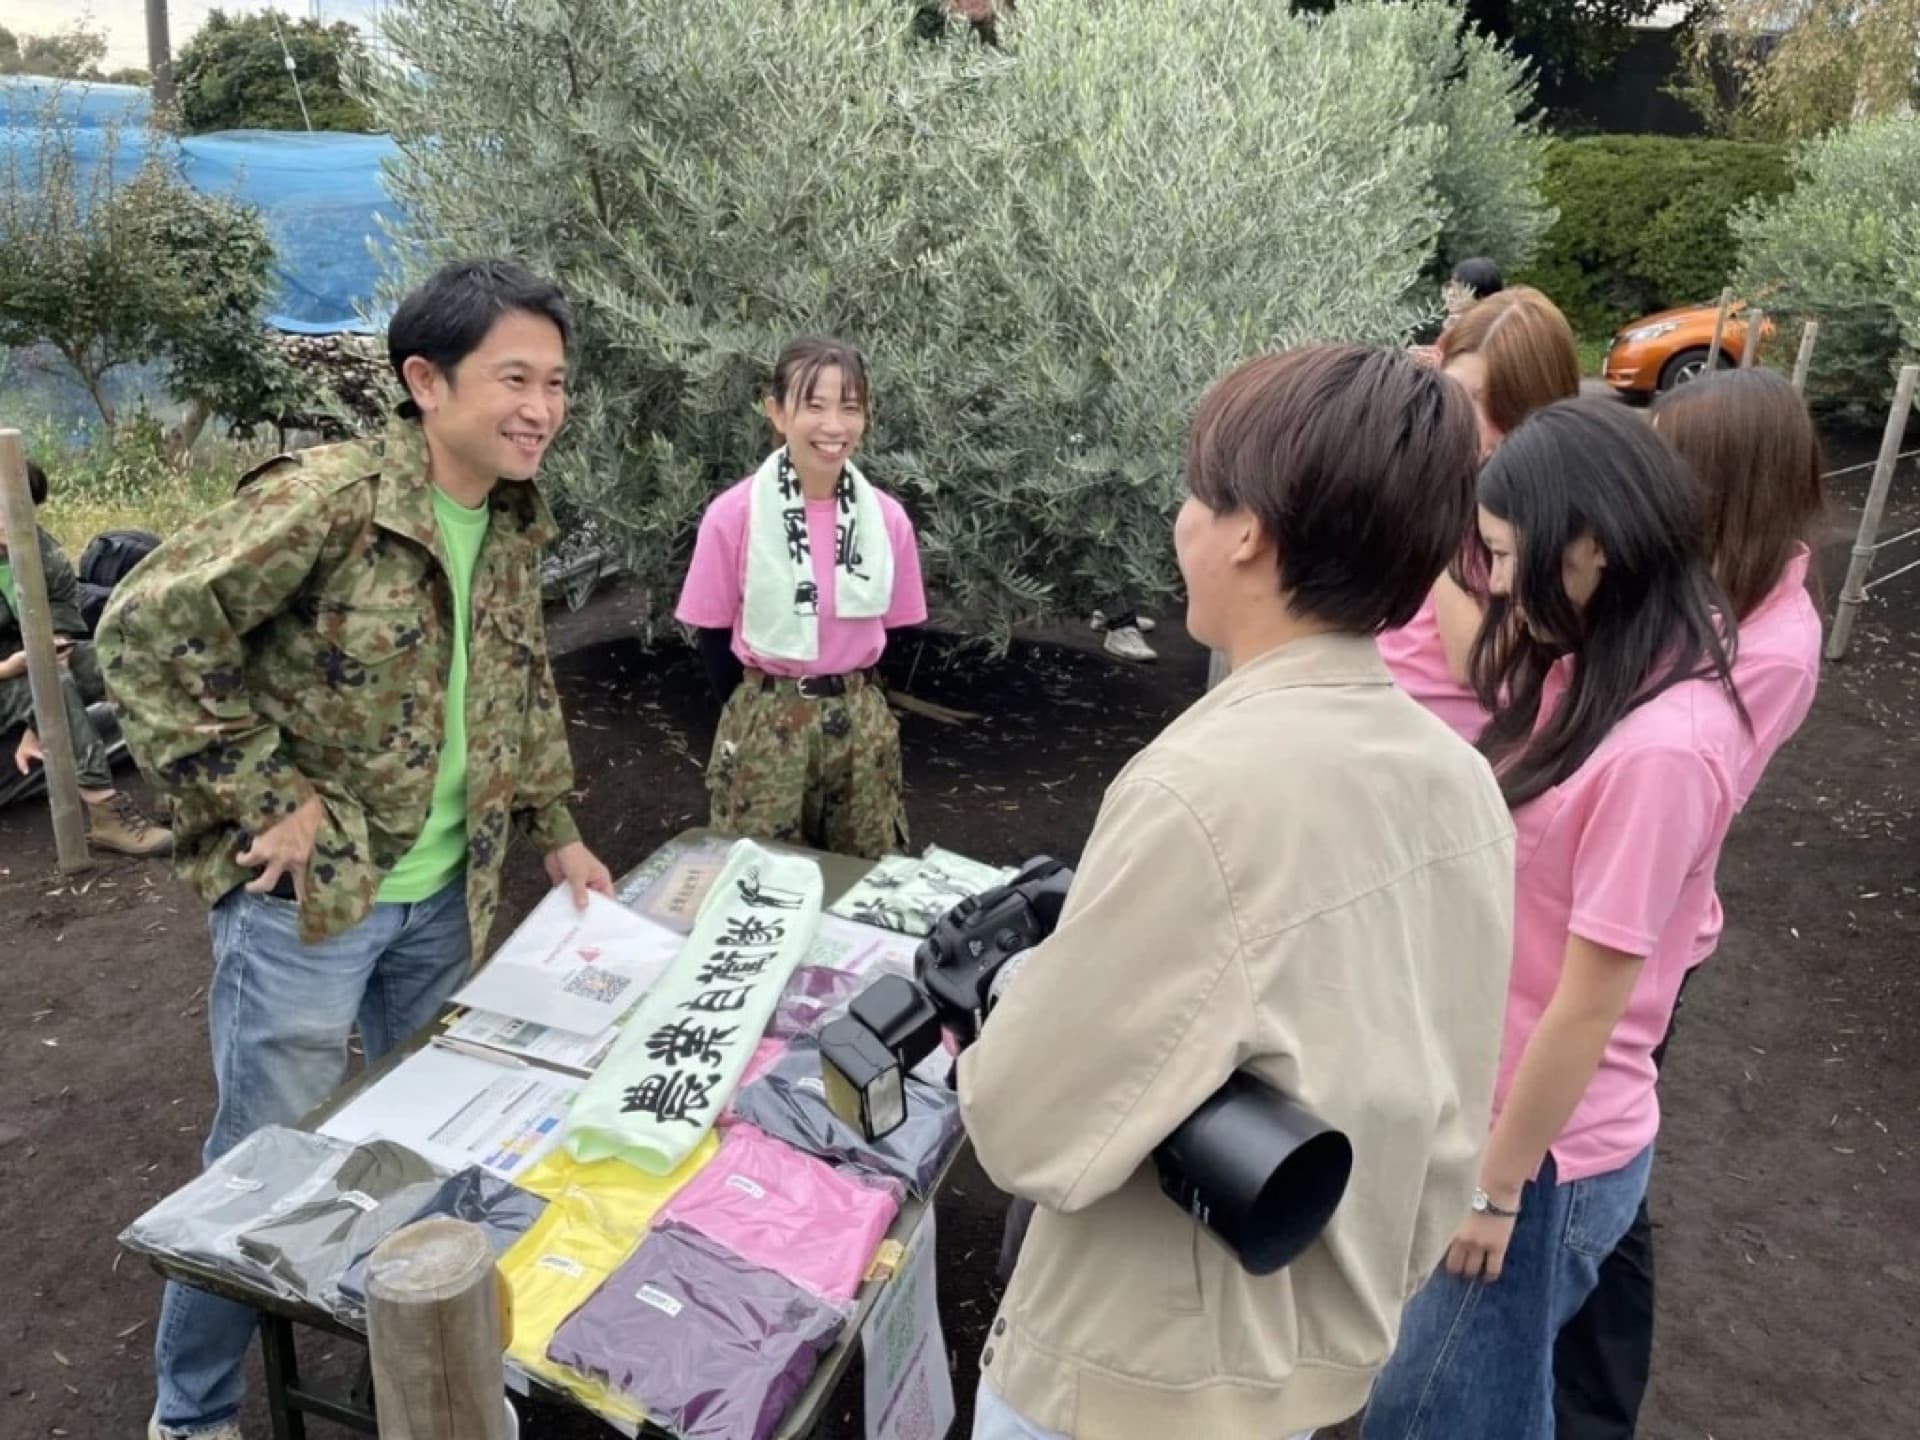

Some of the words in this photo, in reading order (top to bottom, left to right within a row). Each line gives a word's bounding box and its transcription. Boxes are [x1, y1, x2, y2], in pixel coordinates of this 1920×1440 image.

[620, 916, 785, 1127] 農業自衛隊
